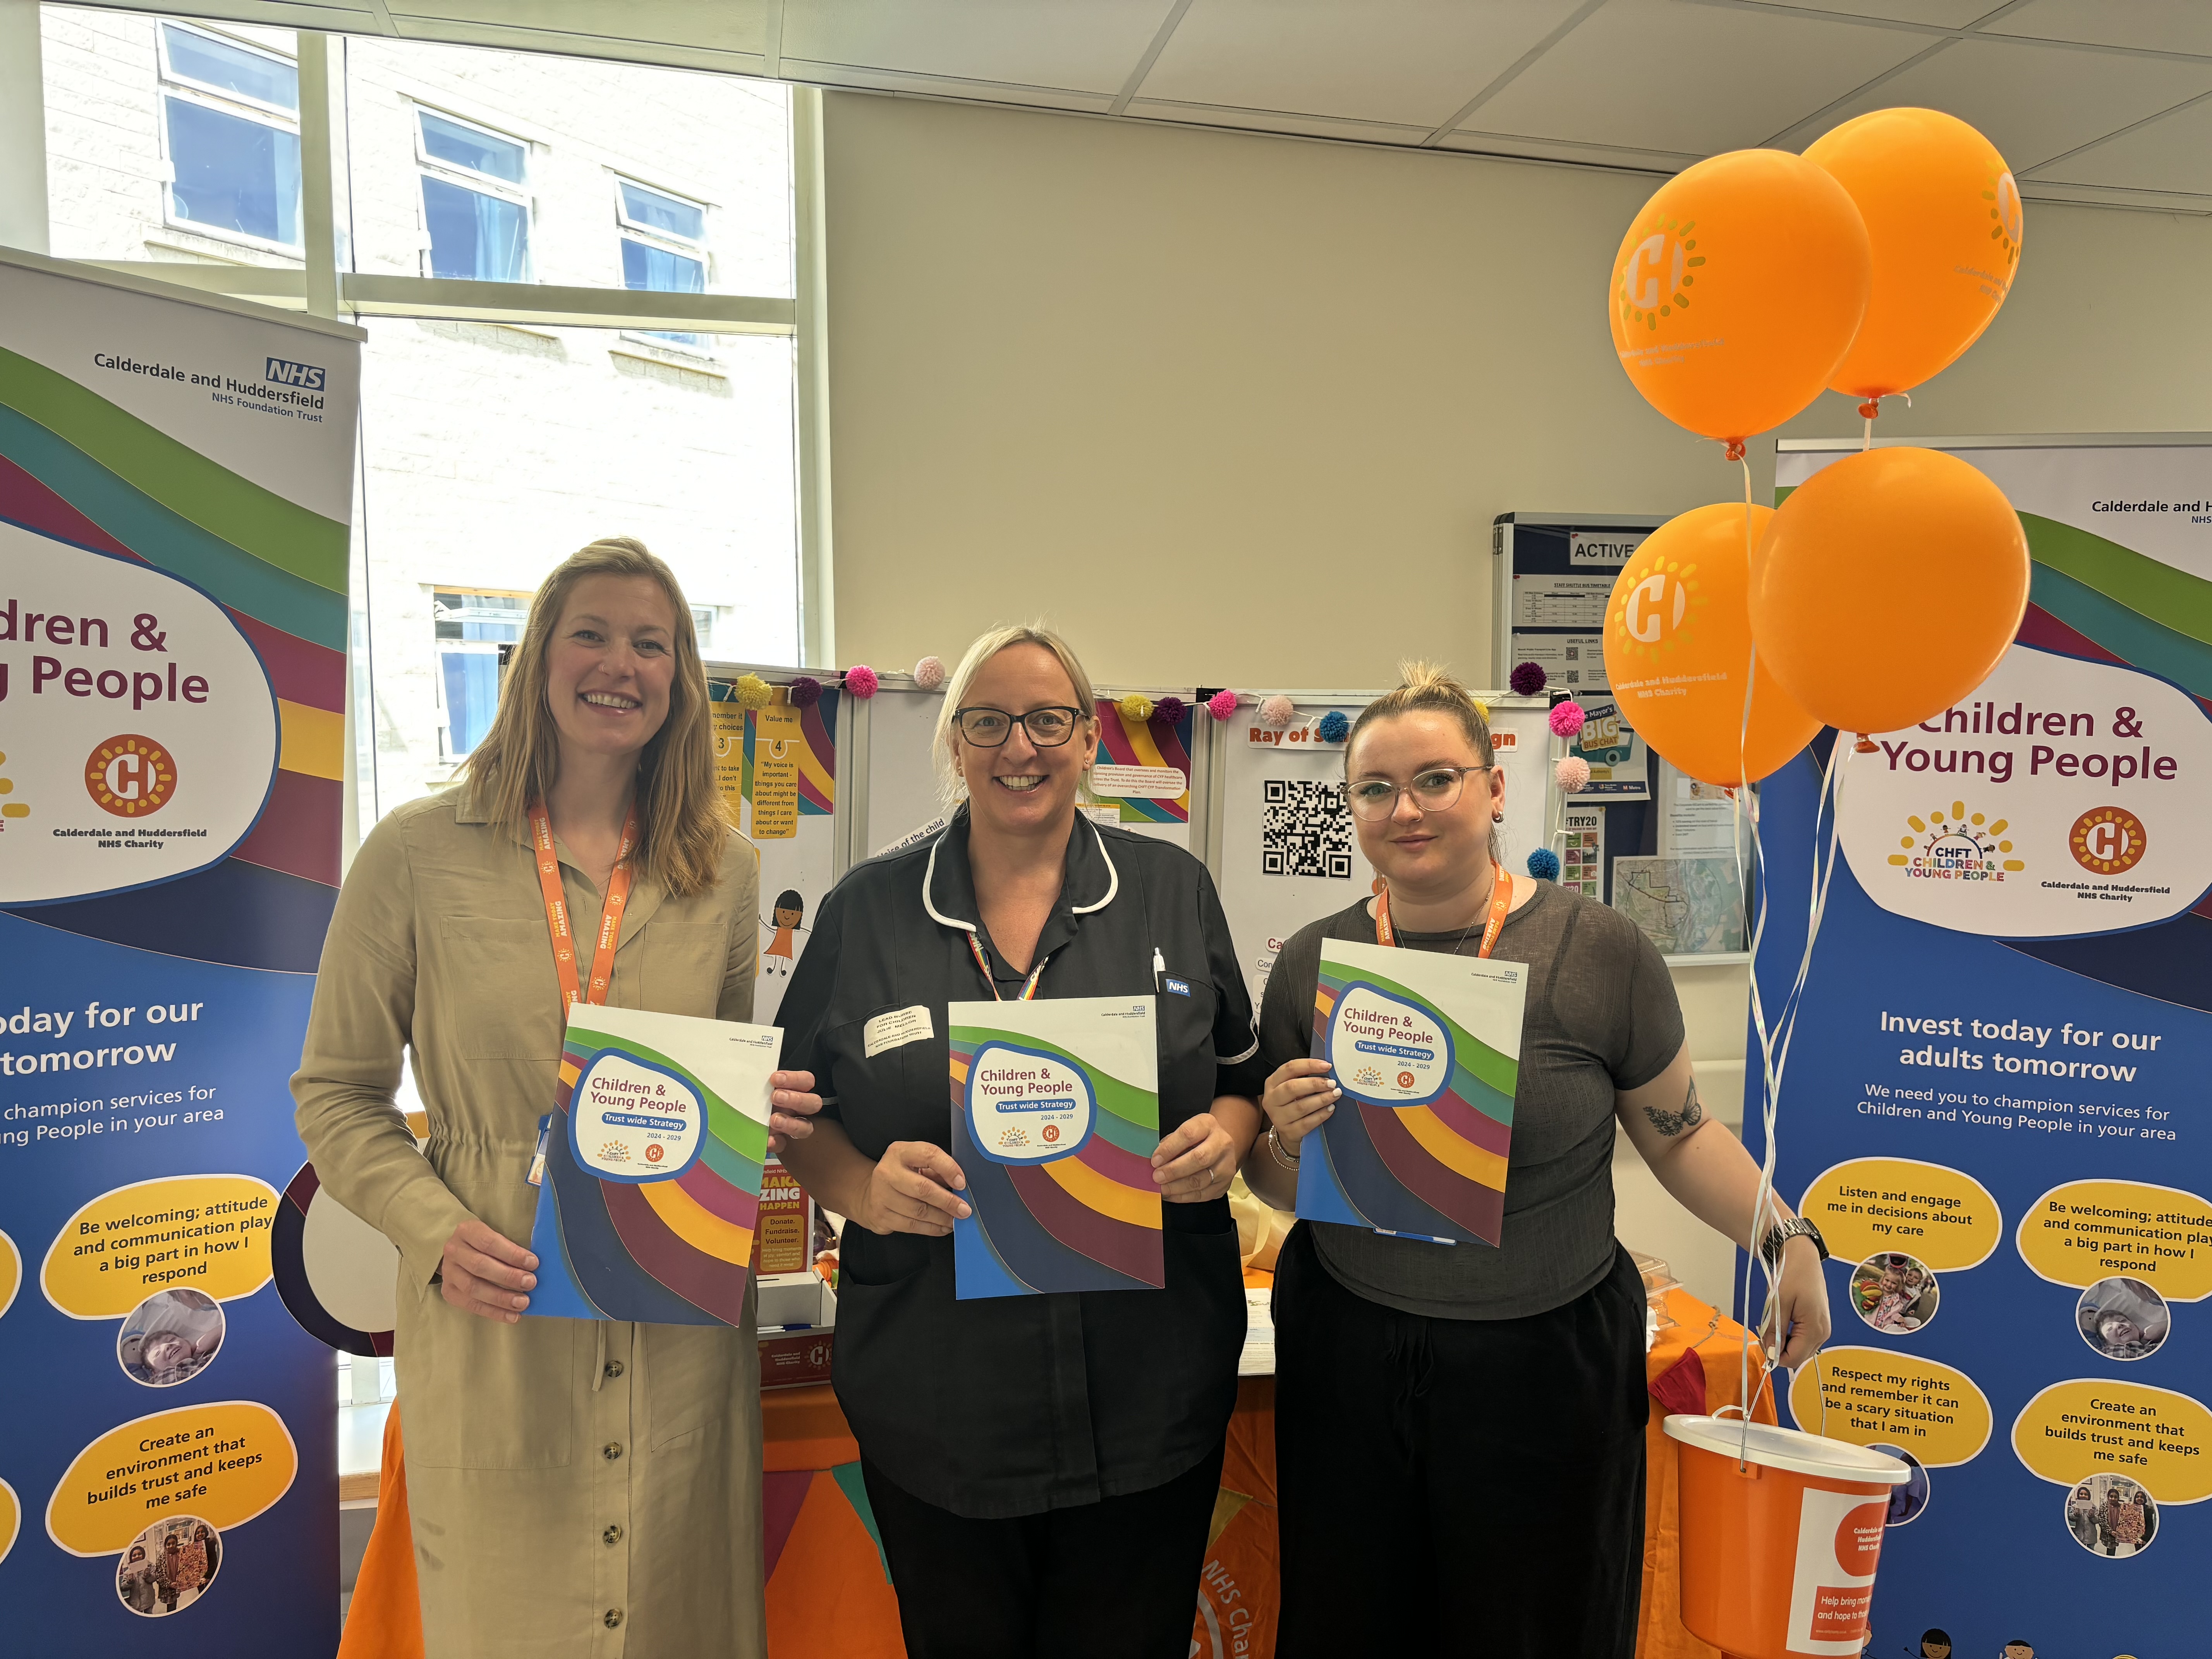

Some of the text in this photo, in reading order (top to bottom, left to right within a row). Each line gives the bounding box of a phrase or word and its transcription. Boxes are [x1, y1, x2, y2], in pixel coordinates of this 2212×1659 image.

[94, 354, 324, 409] Calderdale and Huddersfield
[269, 361, 323, 388] NHS
[213, 393, 322, 422] NHS Foundation Trust
[1575, 544, 1635, 559] ACTIVE
[33, 656, 209, 710] People
[1589, 706, 1613, 717] Mayor's
[2112, 707, 2143, 738] &
[1249, 727, 1309, 745] Ray of
[1583, 717, 1616, 740] BIG
[775, 741, 781, 751] 4
[1584, 737, 1617, 749] BUS CHAT
[1881, 741, 2177, 786] Young People
[124, 840, 164, 849] Charity
[902, 819, 945, 848] of the child
[1913, 857, 1996, 870] CHILDREN &
[1936, 847, 1971, 859] CHFT
[1905, 868, 2004, 881] YOUNG PEOPLE
[555, 901, 567, 936] AMAZING
[1170, 982, 1188, 993] NHS
[1344, 1008, 1412, 1027] Children &
[1344, 1021, 1432, 1044] Young People
[1881, 1012, 2161, 1050] Invest today for our
[981, 1068, 1050, 1081] Children &
[1900, 1045, 2136, 1082] adults tomorrow
[591, 1078, 665, 1096] Children &
[981, 1080, 1072, 1097] Young People
[591, 1092, 686, 1113] Young People
[1865, 1084, 2169, 1120] We need you to champion services for
[605, 1114, 625, 1122] Trust
[649, 1119, 683, 1130] Strategy
[1858, 1102, 2175, 1140] Children and Young People in your area
[760, 1202, 799, 1210] HAPPEN
[1840, 1186, 1961, 1209] Listen and engage
[81, 1197, 267, 1235] Be welcoming; attitude
[1828, 1202, 1972, 1224] me in decisions about
[74, 1216, 272, 1255] and communication play
[1873, 1224, 1923, 1236] my care
[100, 1237, 247, 1271] a big part in how I
[143, 1261, 206, 1284] respond
[1202, 1559, 1241, 1604] NHS
[1821, 1596, 1856, 1607] Help bring
[1818, 1610, 1857, 1622] and hope to
